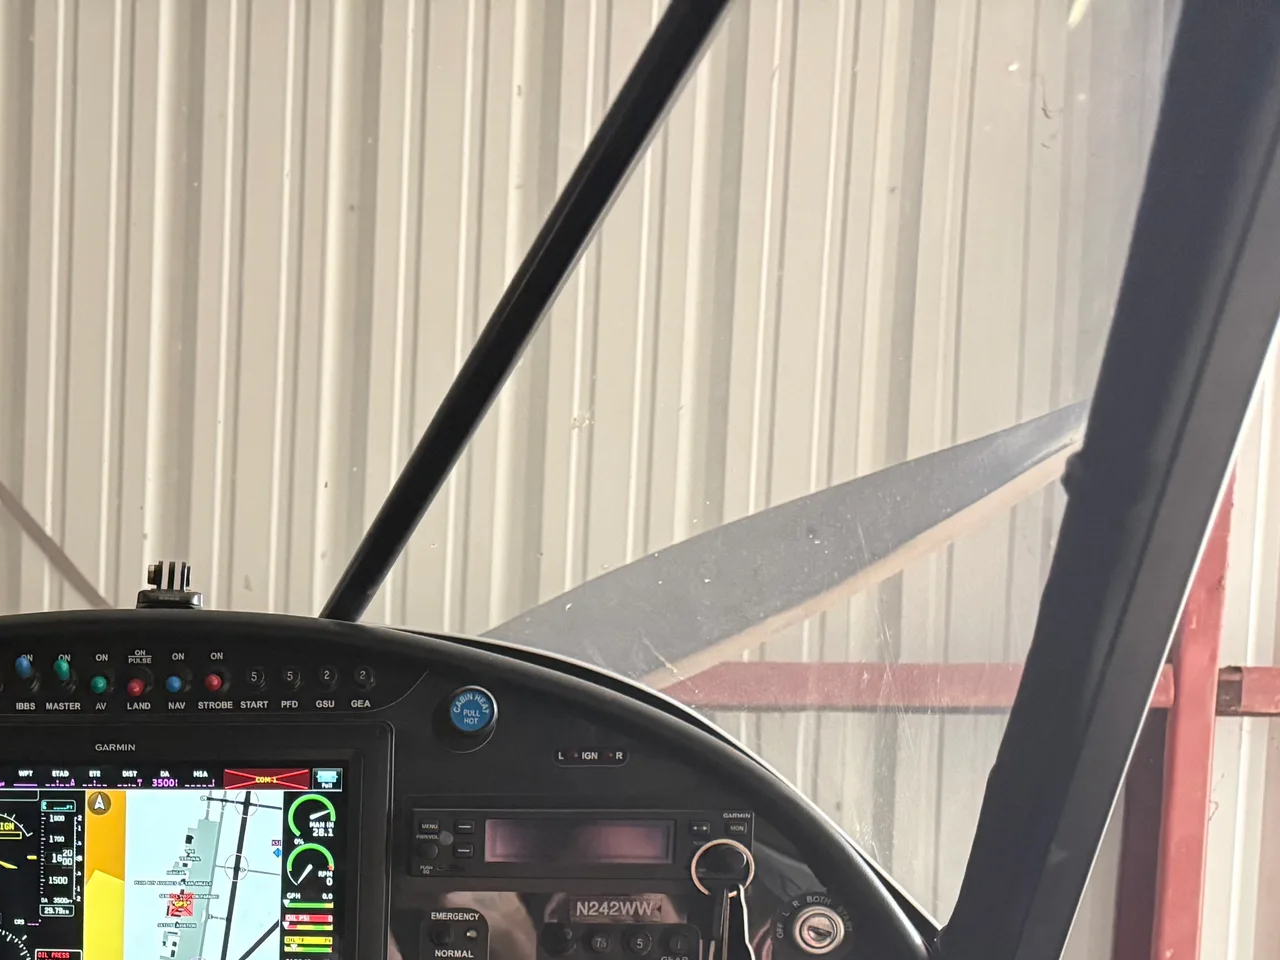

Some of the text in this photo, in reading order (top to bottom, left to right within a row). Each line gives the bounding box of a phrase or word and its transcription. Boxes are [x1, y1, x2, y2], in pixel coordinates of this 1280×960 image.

[95, 653, 109, 661] ON
[171, 652, 185, 660] ON
[209, 652, 223, 660] ON
[251, 671, 257, 681] 5
[286, 671, 293, 681] 5
[323, 670, 330, 680] 2
[359, 670, 366, 680] 2
[15, 702, 36, 711] IBBS
[45, 702, 80, 711] MASTER
[95, 702, 108, 710] AV
[127, 702, 151, 710] LAND
[168, 701, 186, 709] NAV
[197, 701, 233, 709] STROBE
[240, 700, 268, 709] START
[280, 700, 298, 708] PFD
[315, 700, 334, 708] GSU
[350, 700, 370, 708] GEA
[453, 693, 490, 714] CABIN HEAT
[463, 709, 480, 717] PULL
[94, 743, 136, 752] GARMIN
[558, 752, 623, 760] L IGN R
[51, 769, 70, 778] ETAD
[122, 770, 138, 778] DIST
[309, 821, 335, 829] MAN IN
[312, 828, 334, 837] 28.1
[317, 870, 333, 878] RPM
[48, 876, 68, 885] 1500
[326, 877, 333, 886] 0
[792, 900, 801, 908] R
[806, 895, 832, 906] BOTH
[576, 900, 653, 916] N242WW
[430, 911, 480, 921] EMERGENCY
[776, 922, 784, 939] OFF
[636, 938, 643, 949] 5
[434, 949, 475, 959] NORMAL
